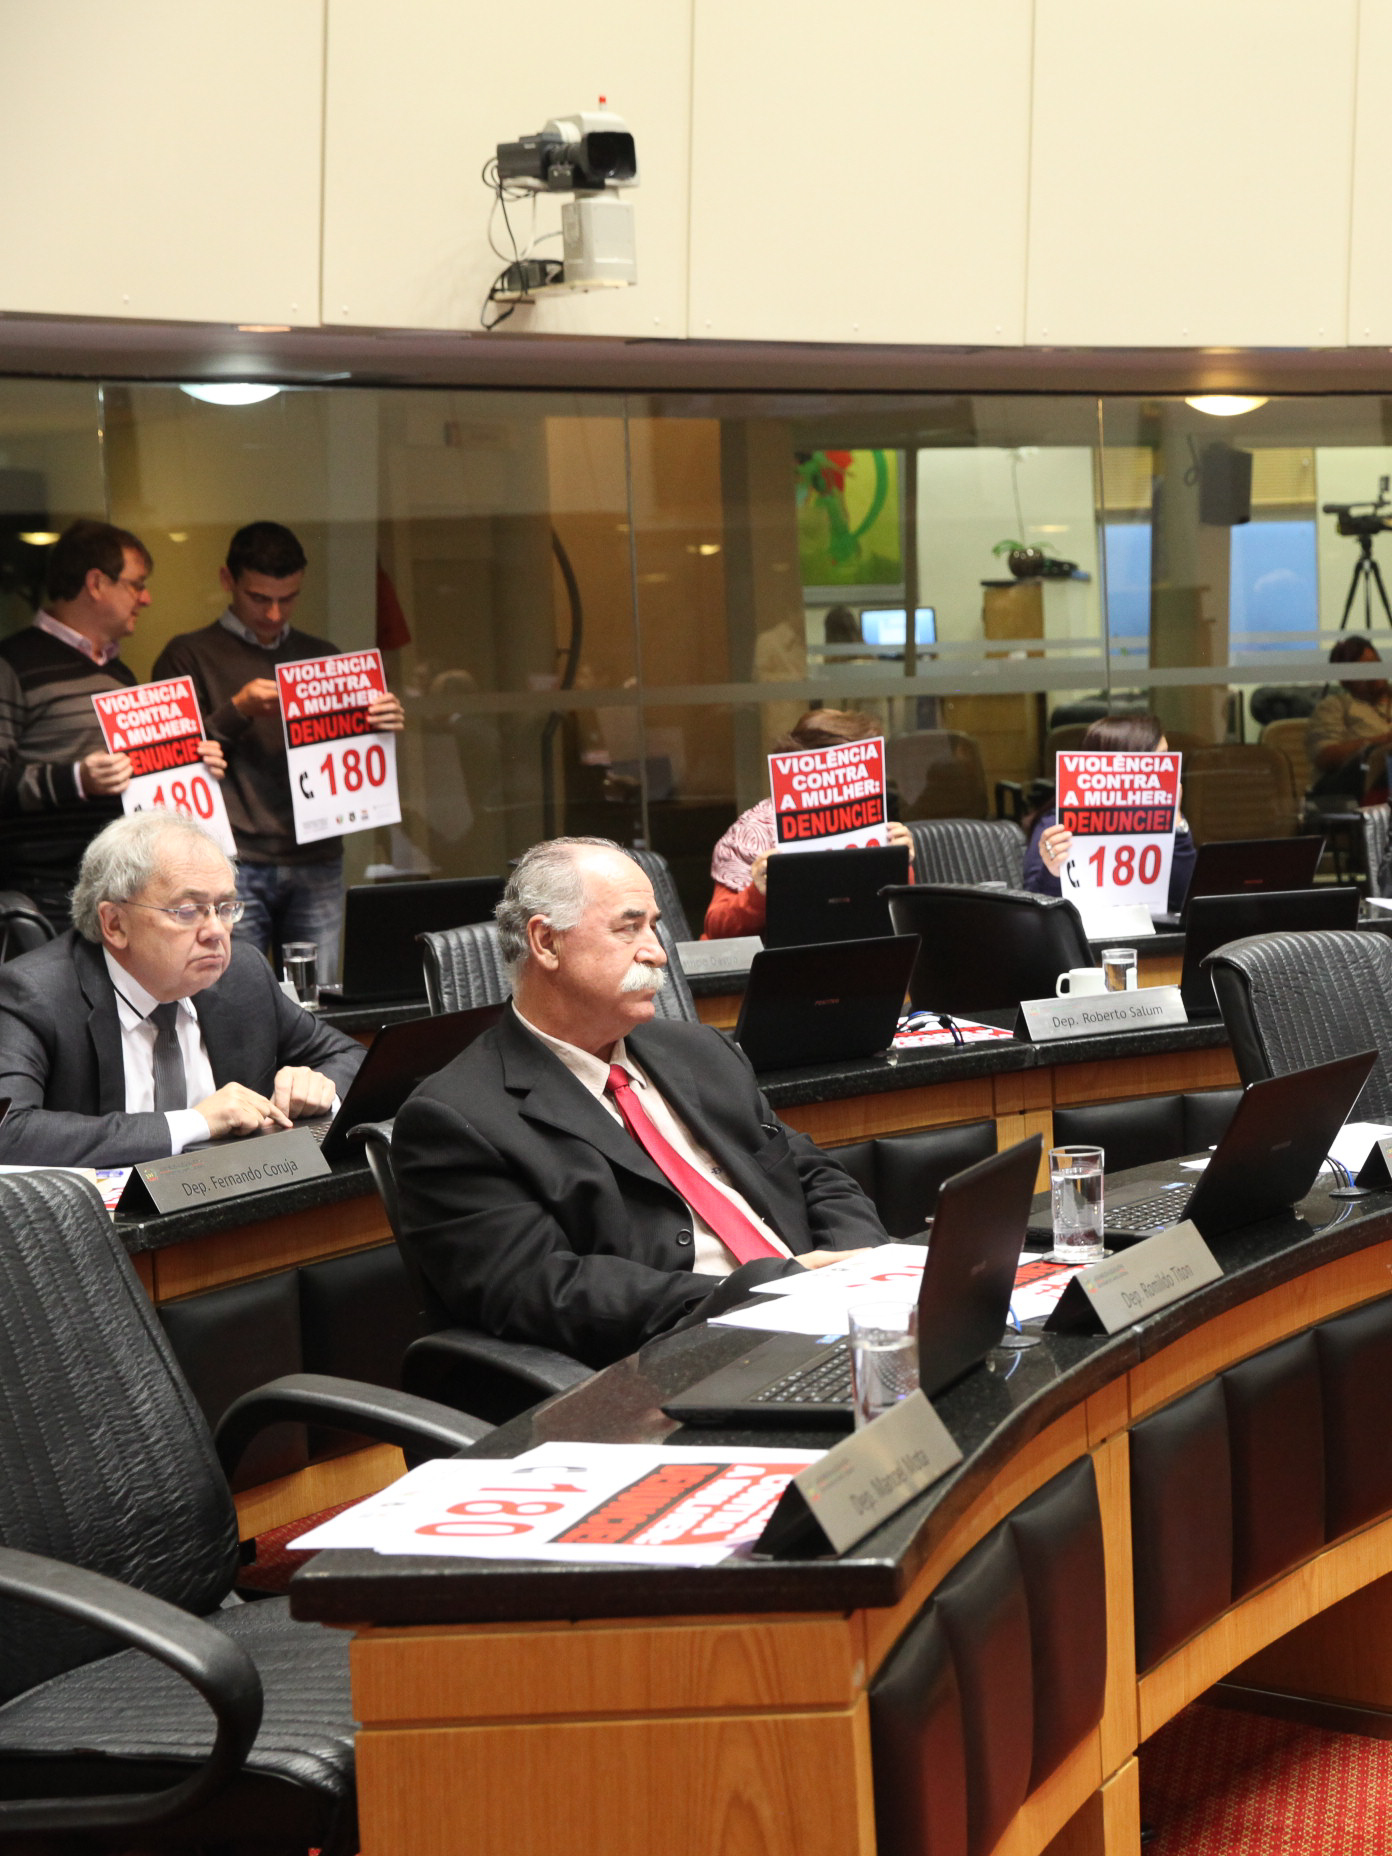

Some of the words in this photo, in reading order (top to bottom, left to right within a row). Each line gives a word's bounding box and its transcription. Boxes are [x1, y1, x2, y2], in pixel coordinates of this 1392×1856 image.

[282, 654, 377, 684] VIOLÊNCIA
[99, 682, 190, 715] VIOLÊNCIA
[295, 673, 372, 699] CONTRA
[116, 702, 183, 730] CONTRA
[287, 702, 300, 718] A
[113, 732, 127, 750] A
[127, 717, 198, 746] MULHER:
[289, 711, 370, 746] DENUNCI
[320, 744, 386, 796] 180
[776, 743, 879, 775] VIOLÊNCIA
[1063, 754, 1174, 773] VIOLÊNCIA
[791, 763, 869, 791] CONTRA
[1076, 774, 1161, 789] CONTRA
[780, 794, 796, 811] A
[801, 778, 881, 808] MULHER:
[1063, 791, 1079, 806] A
[1084, 790, 1173, 806] MULHER:
[781, 798, 883, 840] DENUNCIE!
[1063, 810, 1171, 833] DENUNCIE!
[1089, 844, 1162, 888] 180
[1052, 1016, 1079, 1029] Dep.
[1082, 1009, 1127, 1024] Roberto
[1129, 1005, 1163, 1018] Salum
[181, 1181, 211, 1197] Dep.
[210, 1166, 262, 1190] Fernando
[262, 1158, 299, 1177] Coruja
[1121, 1288, 1145, 1309] Dep.
[414, 1483, 588, 1537] 180
